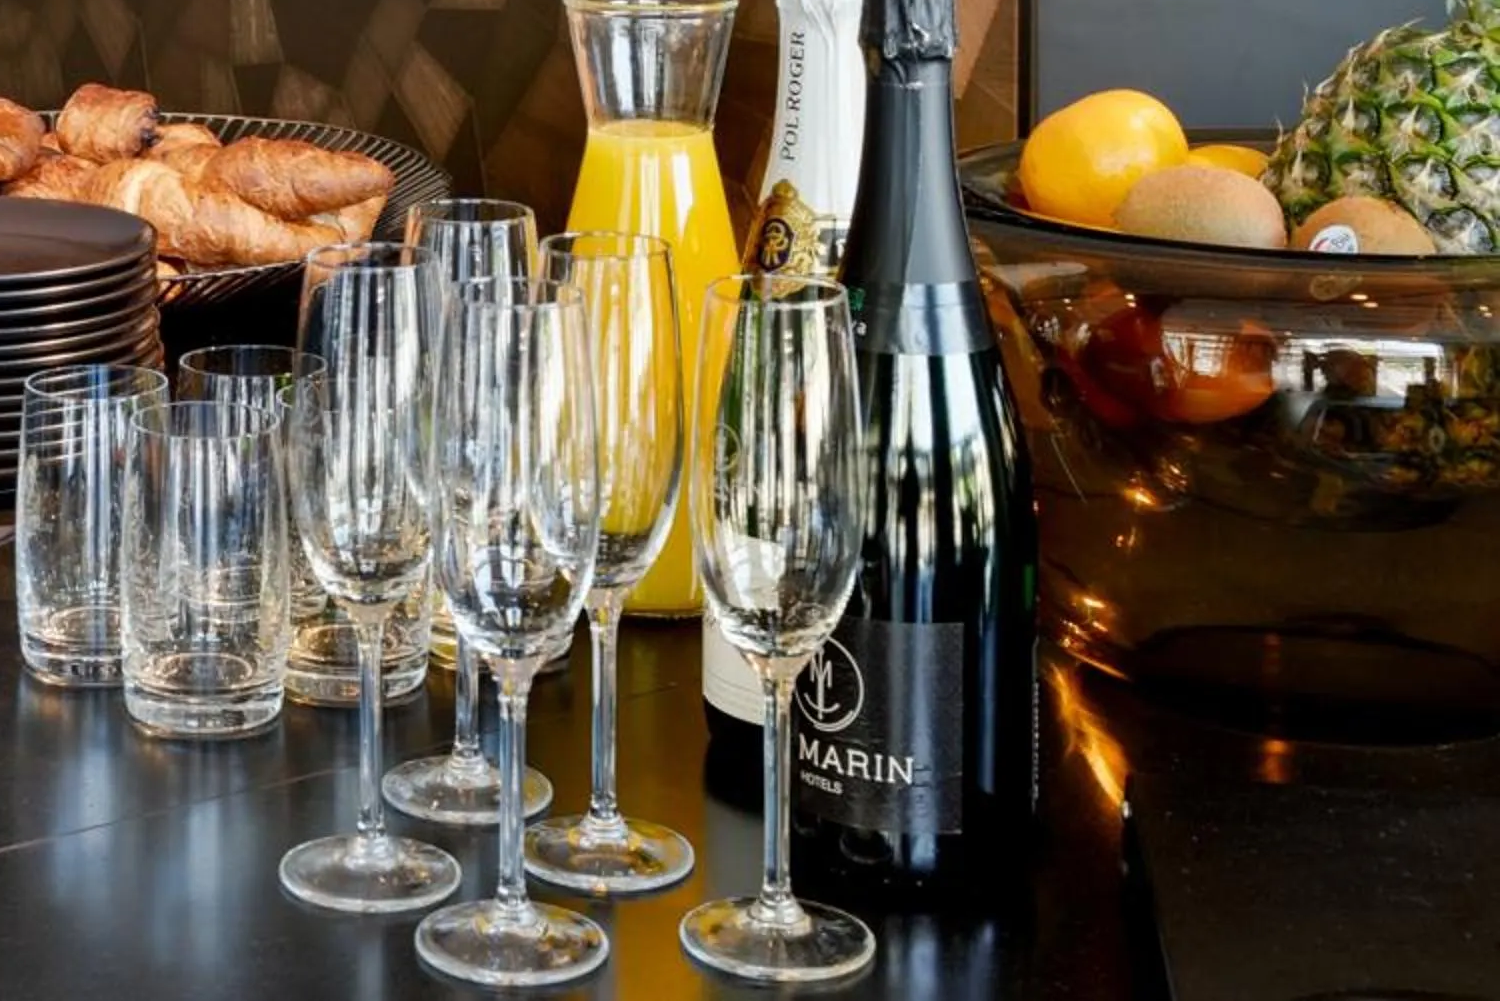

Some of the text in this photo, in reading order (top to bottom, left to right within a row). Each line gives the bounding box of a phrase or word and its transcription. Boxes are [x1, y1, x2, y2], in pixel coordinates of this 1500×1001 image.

[781, 32, 805, 160] POL ROGER
[799, 733, 914, 786] MARIN
[800, 770, 844, 795] HOTELS
